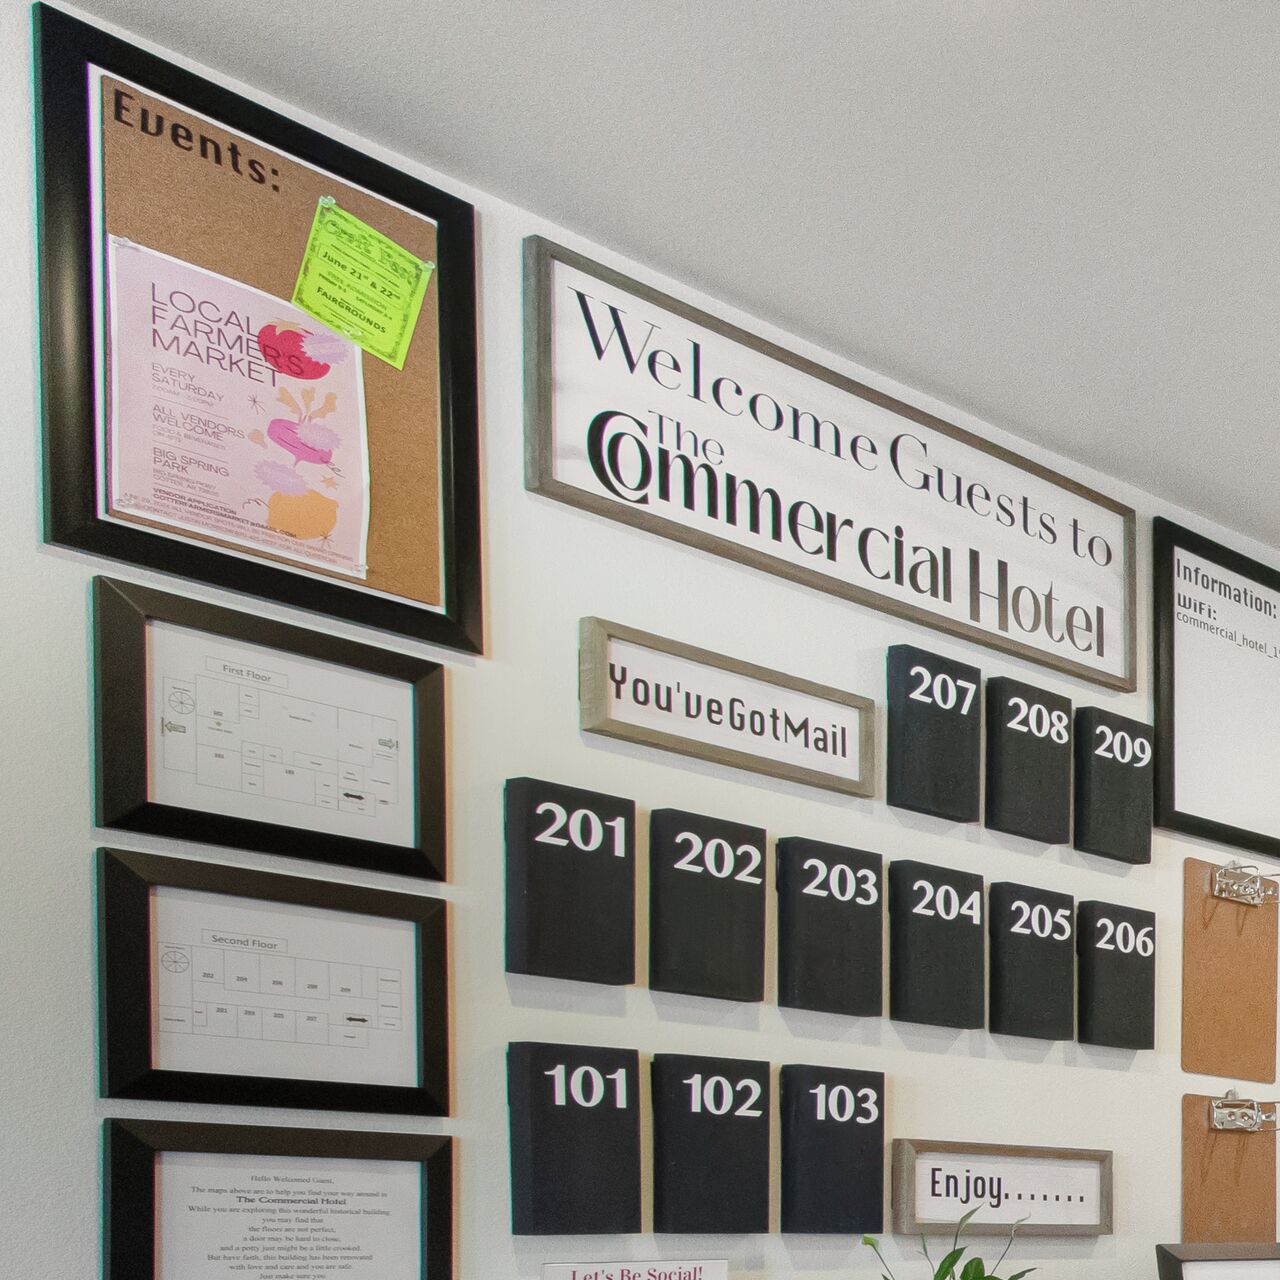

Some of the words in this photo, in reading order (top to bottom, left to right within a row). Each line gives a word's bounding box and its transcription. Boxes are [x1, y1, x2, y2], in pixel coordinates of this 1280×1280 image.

[113, 89, 281, 193] Events:
[323, 252, 347, 271] June
[152, 283, 258, 337] LOCAL
[317, 286, 387, 333] FAIRGROUNDS
[152, 305, 304, 376] FARMERS
[152, 329, 282, 387] MARKET
[152, 362, 195, 382] EVERY
[152, 373, 224, 401] SATURDAY
[153, 404, 176, 417] ALL
[181, 412, 245, 439] VENDORS
[153, 413, 224, 441] WELCOME
[567, 286, 879, 472] Welcome
[889, 433, 1059, 545] Guests
[1069, 518, 1113, 567] to
[648, 410, 725, 466] The
[153, 447, 176, 461] BIG
[180, 455, 230, 477] SPRING
[153, 457, 189, 474] PARK
[153, 488, 186, 500] VENDOR
[187, 497, 237, 515] APPLICATION
[586, 410, 952, 604] Commercial
[968, 547, 1105, 658] Hotel
[1176, 558, 1277, 619] Information:
[1177, 593, 1217, 621] WiFi:
[223, 664, 244, 675] First
[246, 670, 272, 682] Floor
[909, 665, 976, 717] 207
[1007, 695, 1069, 745] 208
[1095, 724, 1152, 767] 209
[534, 802, 627, 858] 201
[674, 831, 762, 885] 202
[802, 858, 879, 907] 203
[912, 879, 982, 926] 204
[211, 935, 249, 947] Second
[252, 939, 278, 950] Floor
[1010, 900, 1072, 942] 205
[1095, 917, 1154, 958] 206
[544, 1064, 627, 1110] 101
[683, 1074, 763, 1117] 102
[809, 1083, 880, 1124] 103
